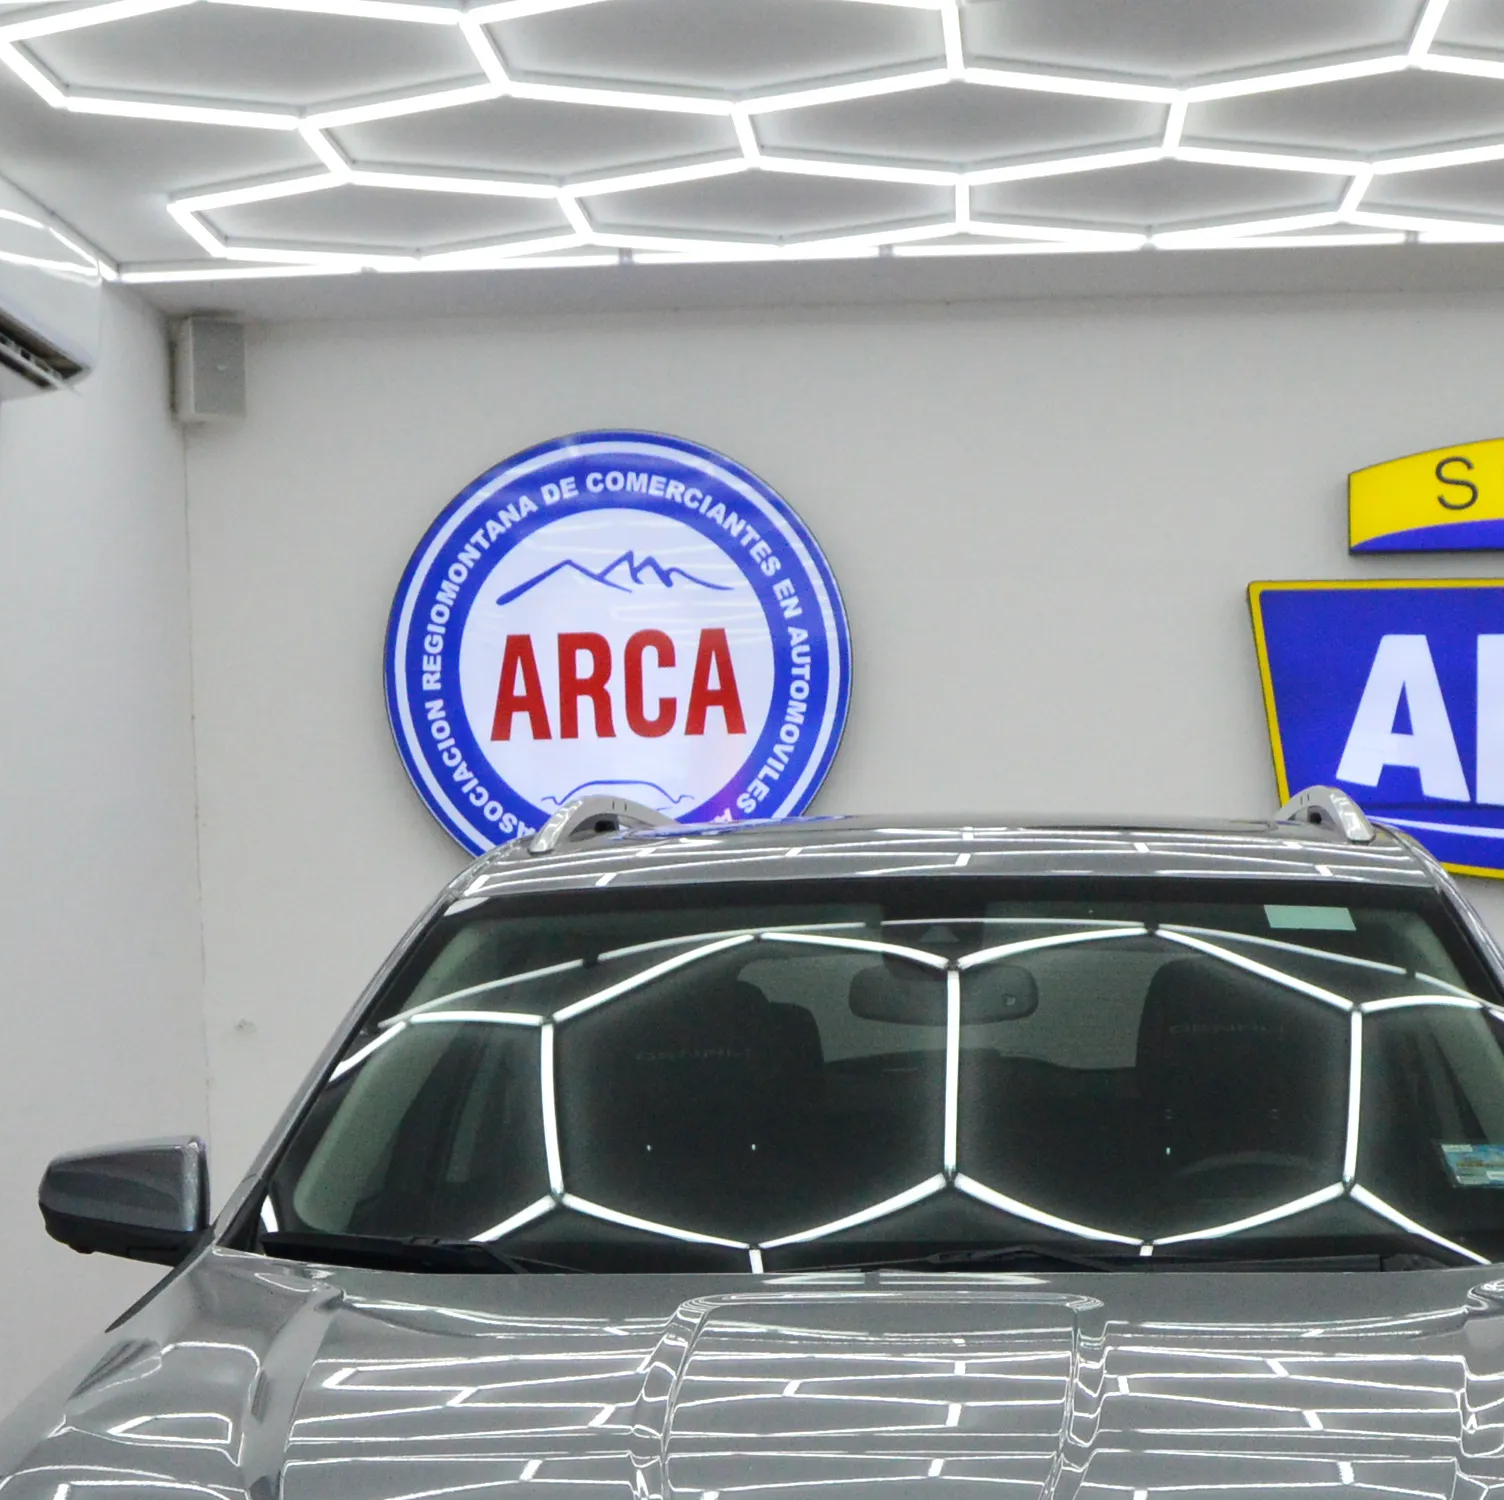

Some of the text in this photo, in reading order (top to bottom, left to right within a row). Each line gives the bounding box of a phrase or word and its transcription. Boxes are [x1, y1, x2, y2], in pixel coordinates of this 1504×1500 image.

[540, 476, 579, 505] DE
[585, 471, 782, 577] COMERCIANTES
[422, 495, 539, 691] REGIOMONTANA
[773, 578, 803, 619] EN
[490, 627, 747, 742] ARCA
[736, 626, 811, 814] AUTOMOVILES
